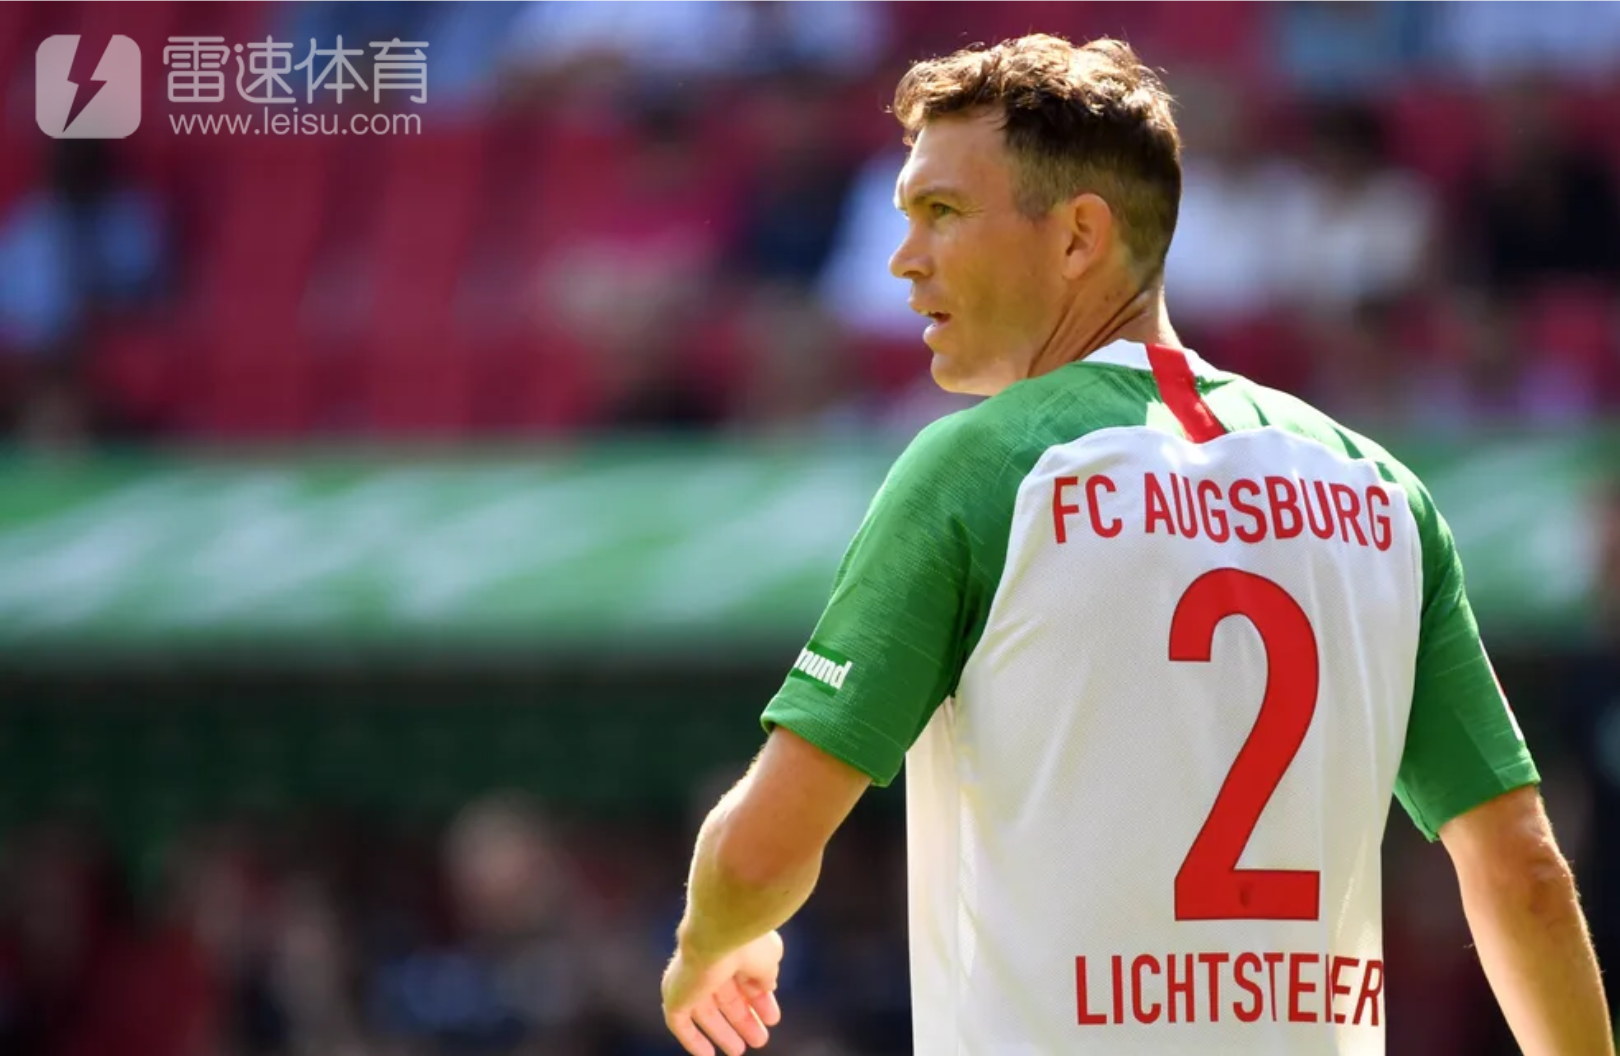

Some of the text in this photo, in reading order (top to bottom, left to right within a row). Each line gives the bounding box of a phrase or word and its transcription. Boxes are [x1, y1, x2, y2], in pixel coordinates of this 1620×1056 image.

[1053, 472, 1393, 552] FC AUGSBURG
[1168, 567, 1320, 921] 2
